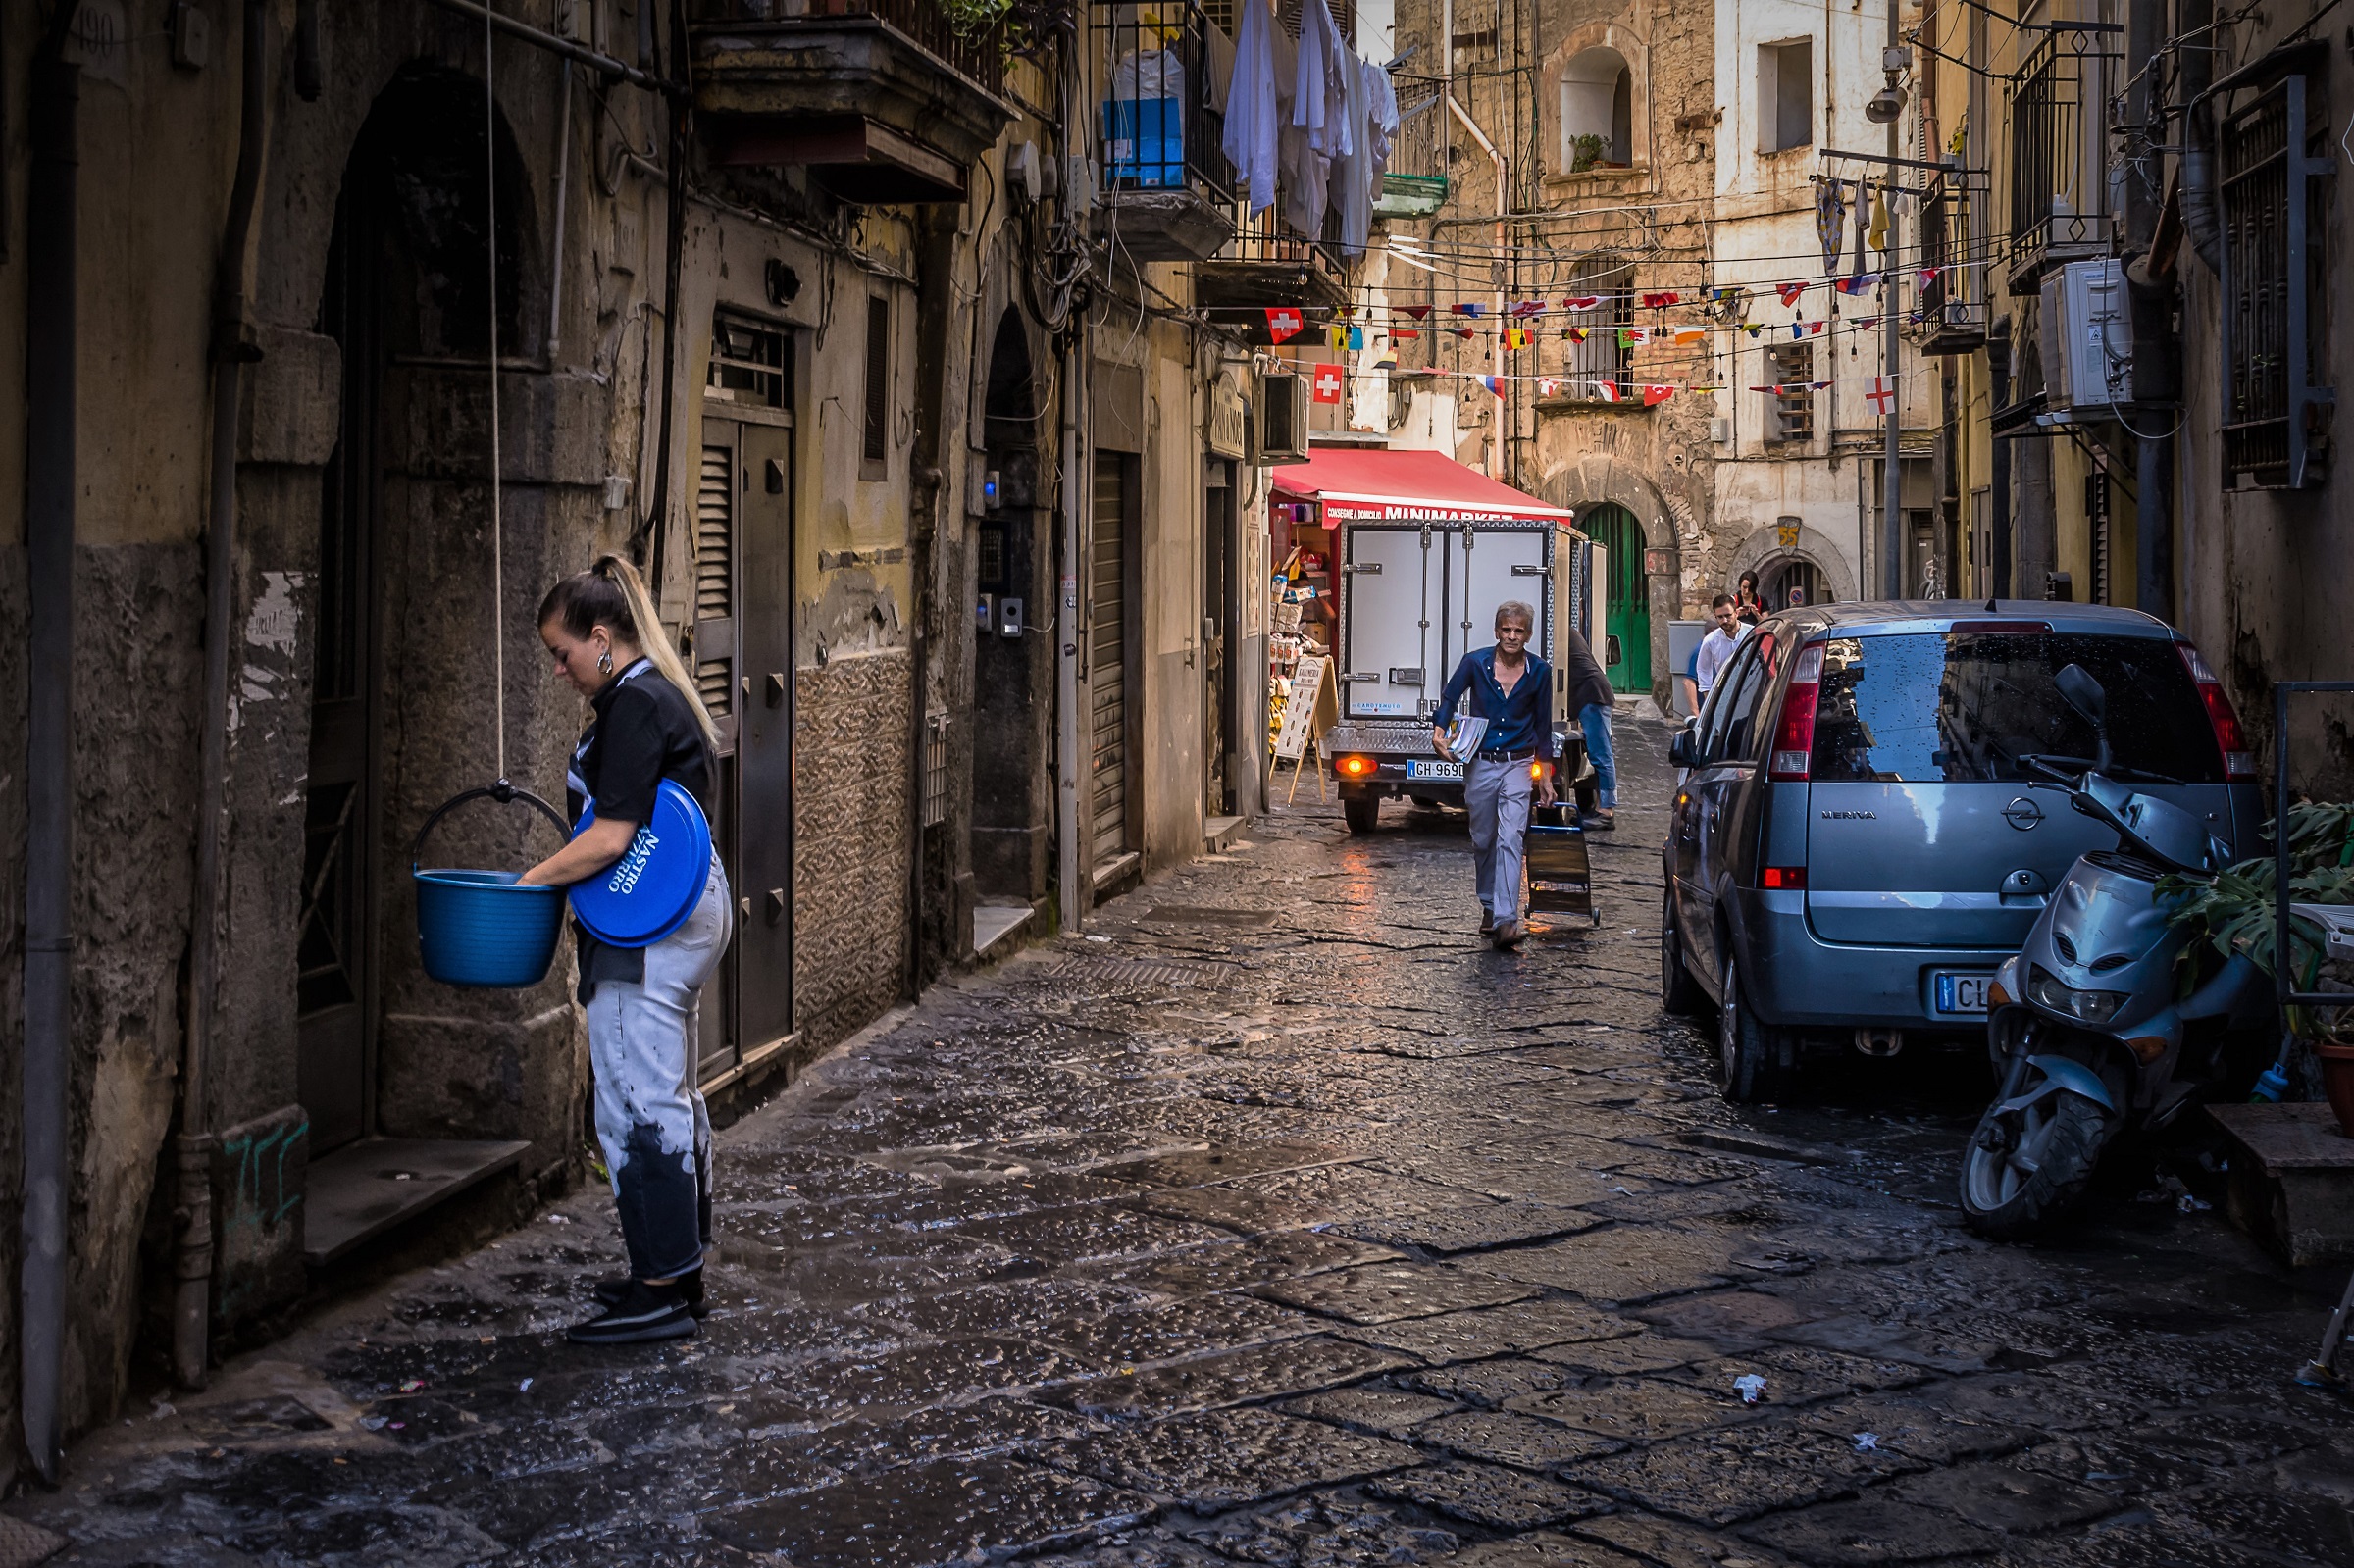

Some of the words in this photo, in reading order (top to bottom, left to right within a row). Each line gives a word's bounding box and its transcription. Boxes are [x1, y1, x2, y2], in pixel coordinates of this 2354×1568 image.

[79, 6, 114, 60] 190
[1327, 507, 1354, 519] CONSEGNE
[1354, 508, 1358, 520] A
[1358, 509, 1382, 520] DOMICILIO
[1778, 527, 1798, 546] 55
[1416, 763, 1431, 776] GH
[1436, 763, 1464, 777] 969D
[1821, 810, 1877, 820] MERIVA
[608, 824, 651, 893] AZZURRO
[621, 833, 660, 895] NASTRO
[1958, 979, 1988, 1008] CL
